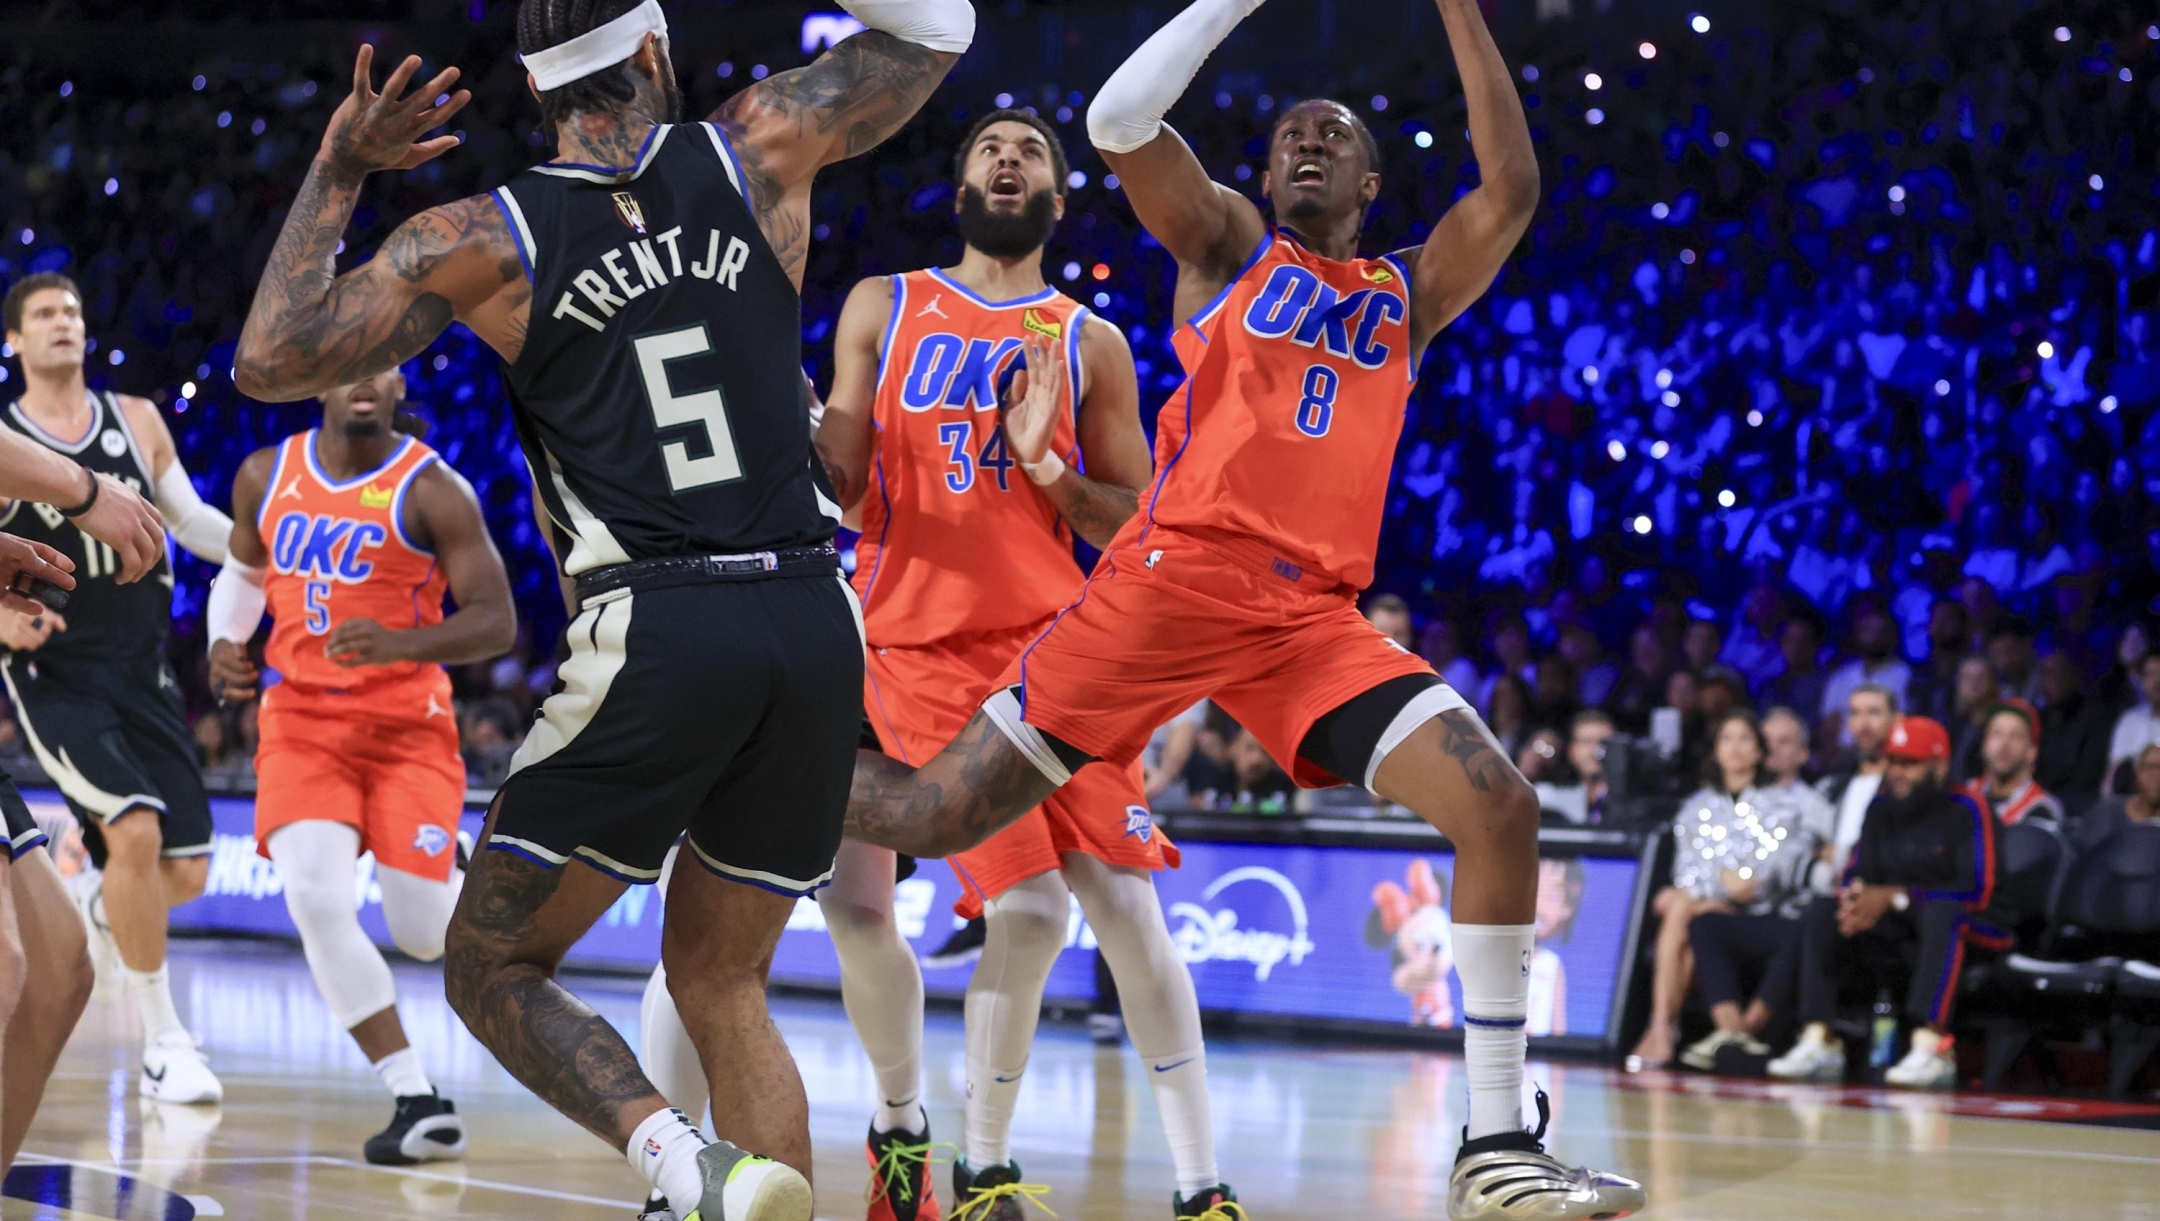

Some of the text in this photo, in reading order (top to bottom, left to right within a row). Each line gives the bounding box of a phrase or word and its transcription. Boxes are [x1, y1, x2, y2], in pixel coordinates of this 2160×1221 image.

[552, 225, 750, 332] TRENT JR
[1243, 264, 1405, 370] OKC
[627, 319, 748, 496] 5
[1294, 363, 1339, 438] 8
[938, 420, 1016, 494] 34
[272, 510, 388, 585] OKC
[305, 580, 331, 636] 5
[1168, 900, 1315, 983] Disney+
